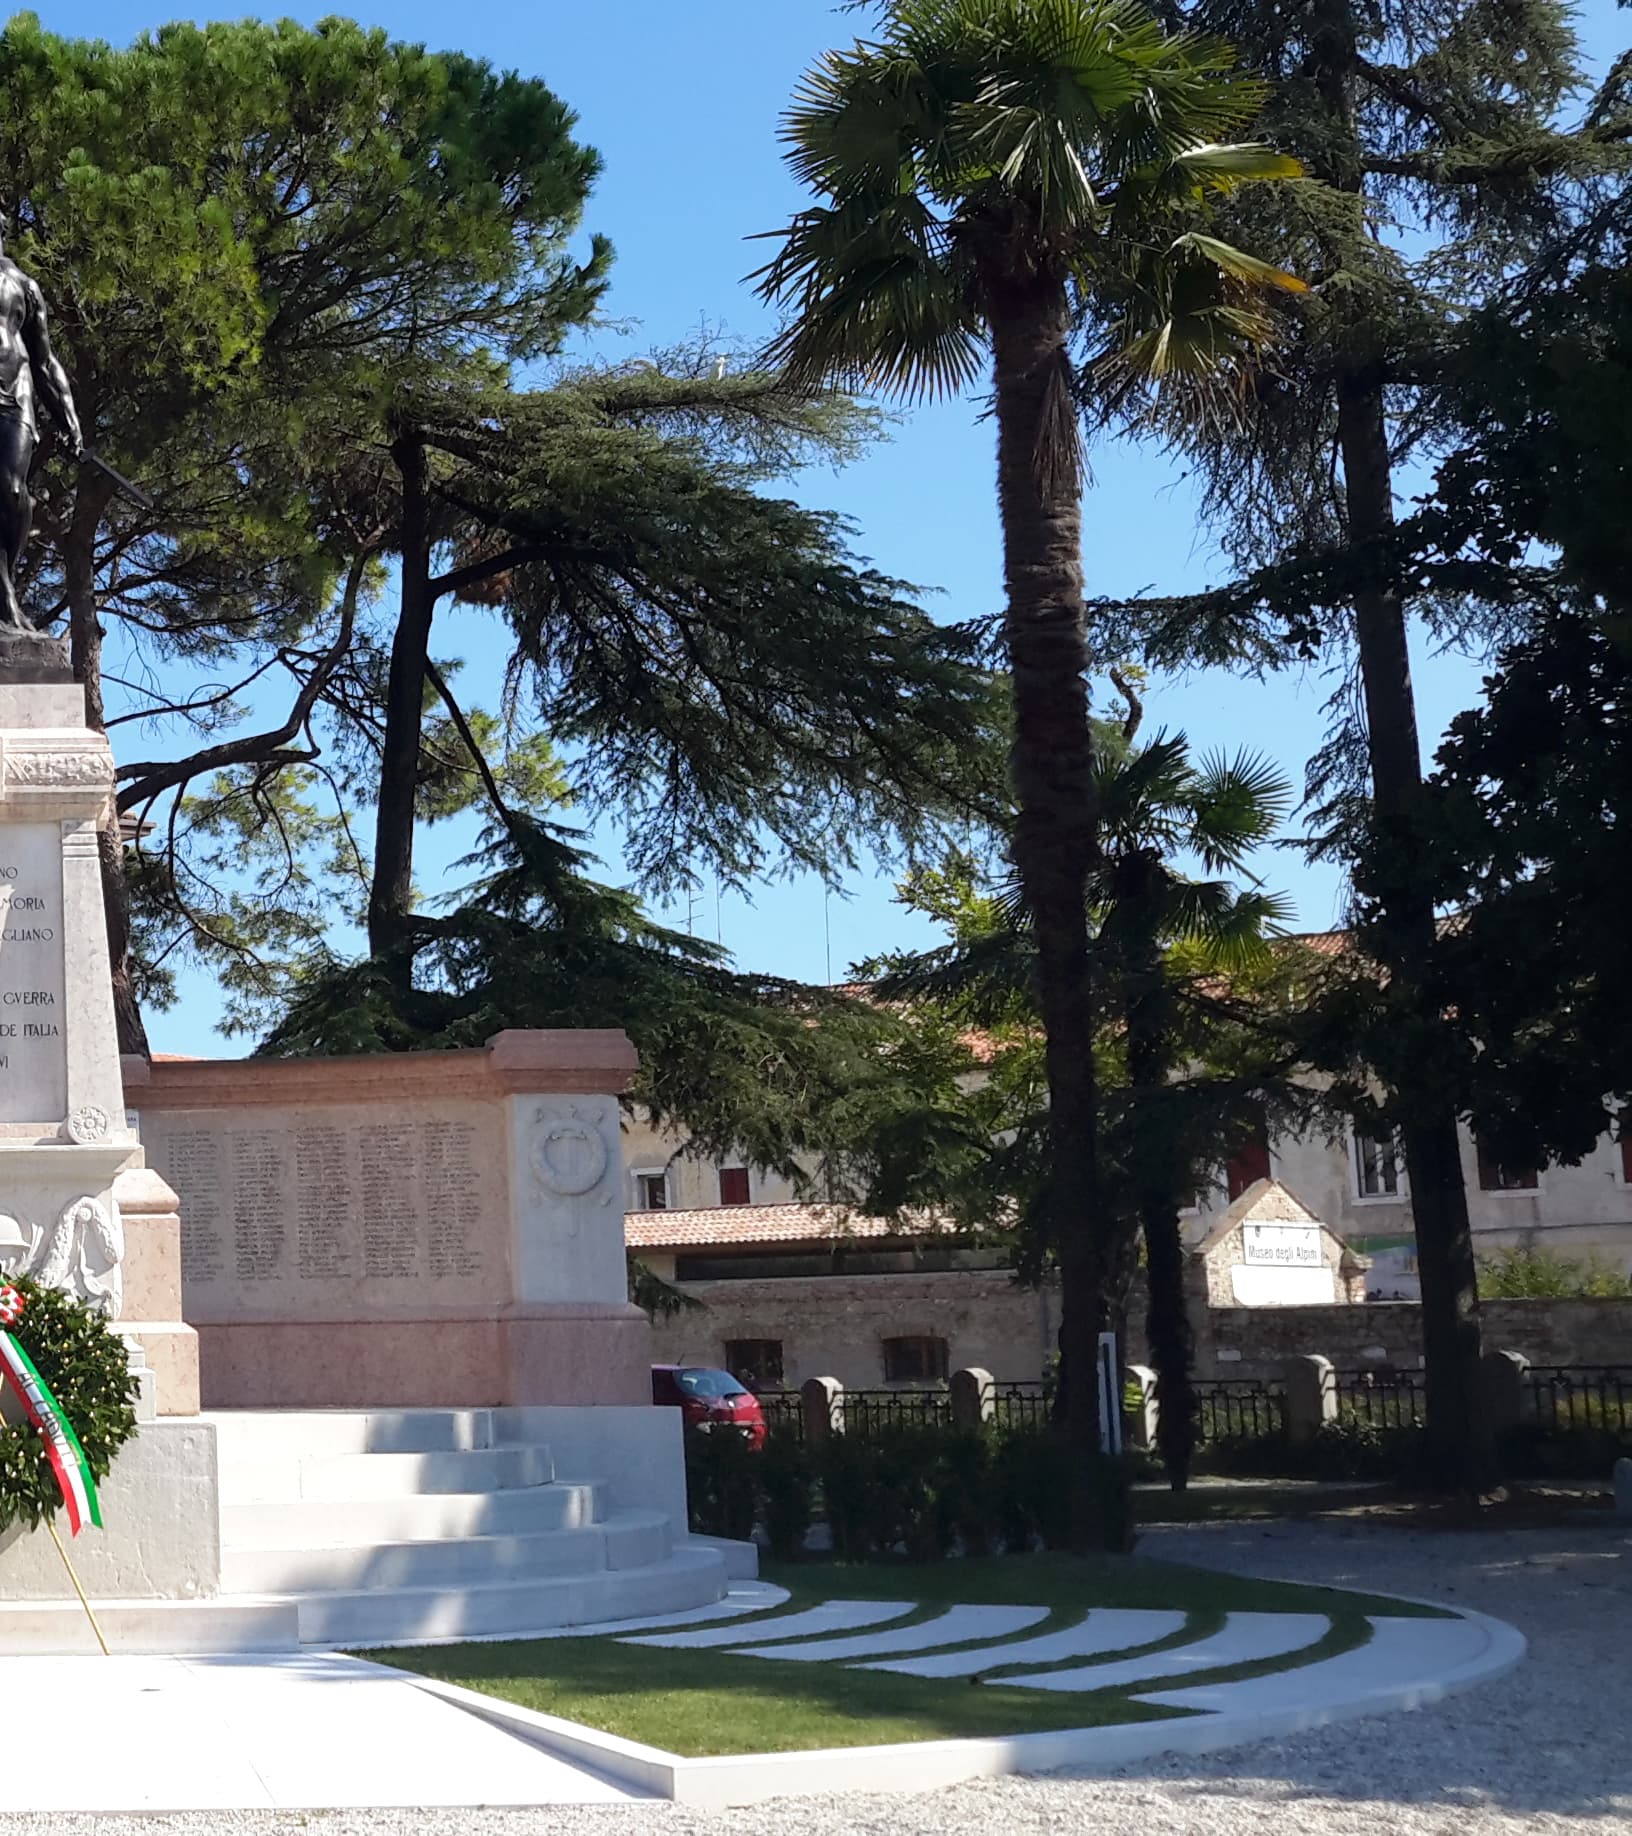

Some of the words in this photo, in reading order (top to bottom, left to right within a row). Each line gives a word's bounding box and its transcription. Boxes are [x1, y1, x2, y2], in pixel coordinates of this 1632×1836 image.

[3, 991, 55, 1006] GVERRA
[23, 1023, 59, 1037] ITALIA
[1248, 1245, 1274, 1259] Museo
[1275, 1247, 1294, 1263] degli
[1296, 1246, 1318, 1262] Alpini
